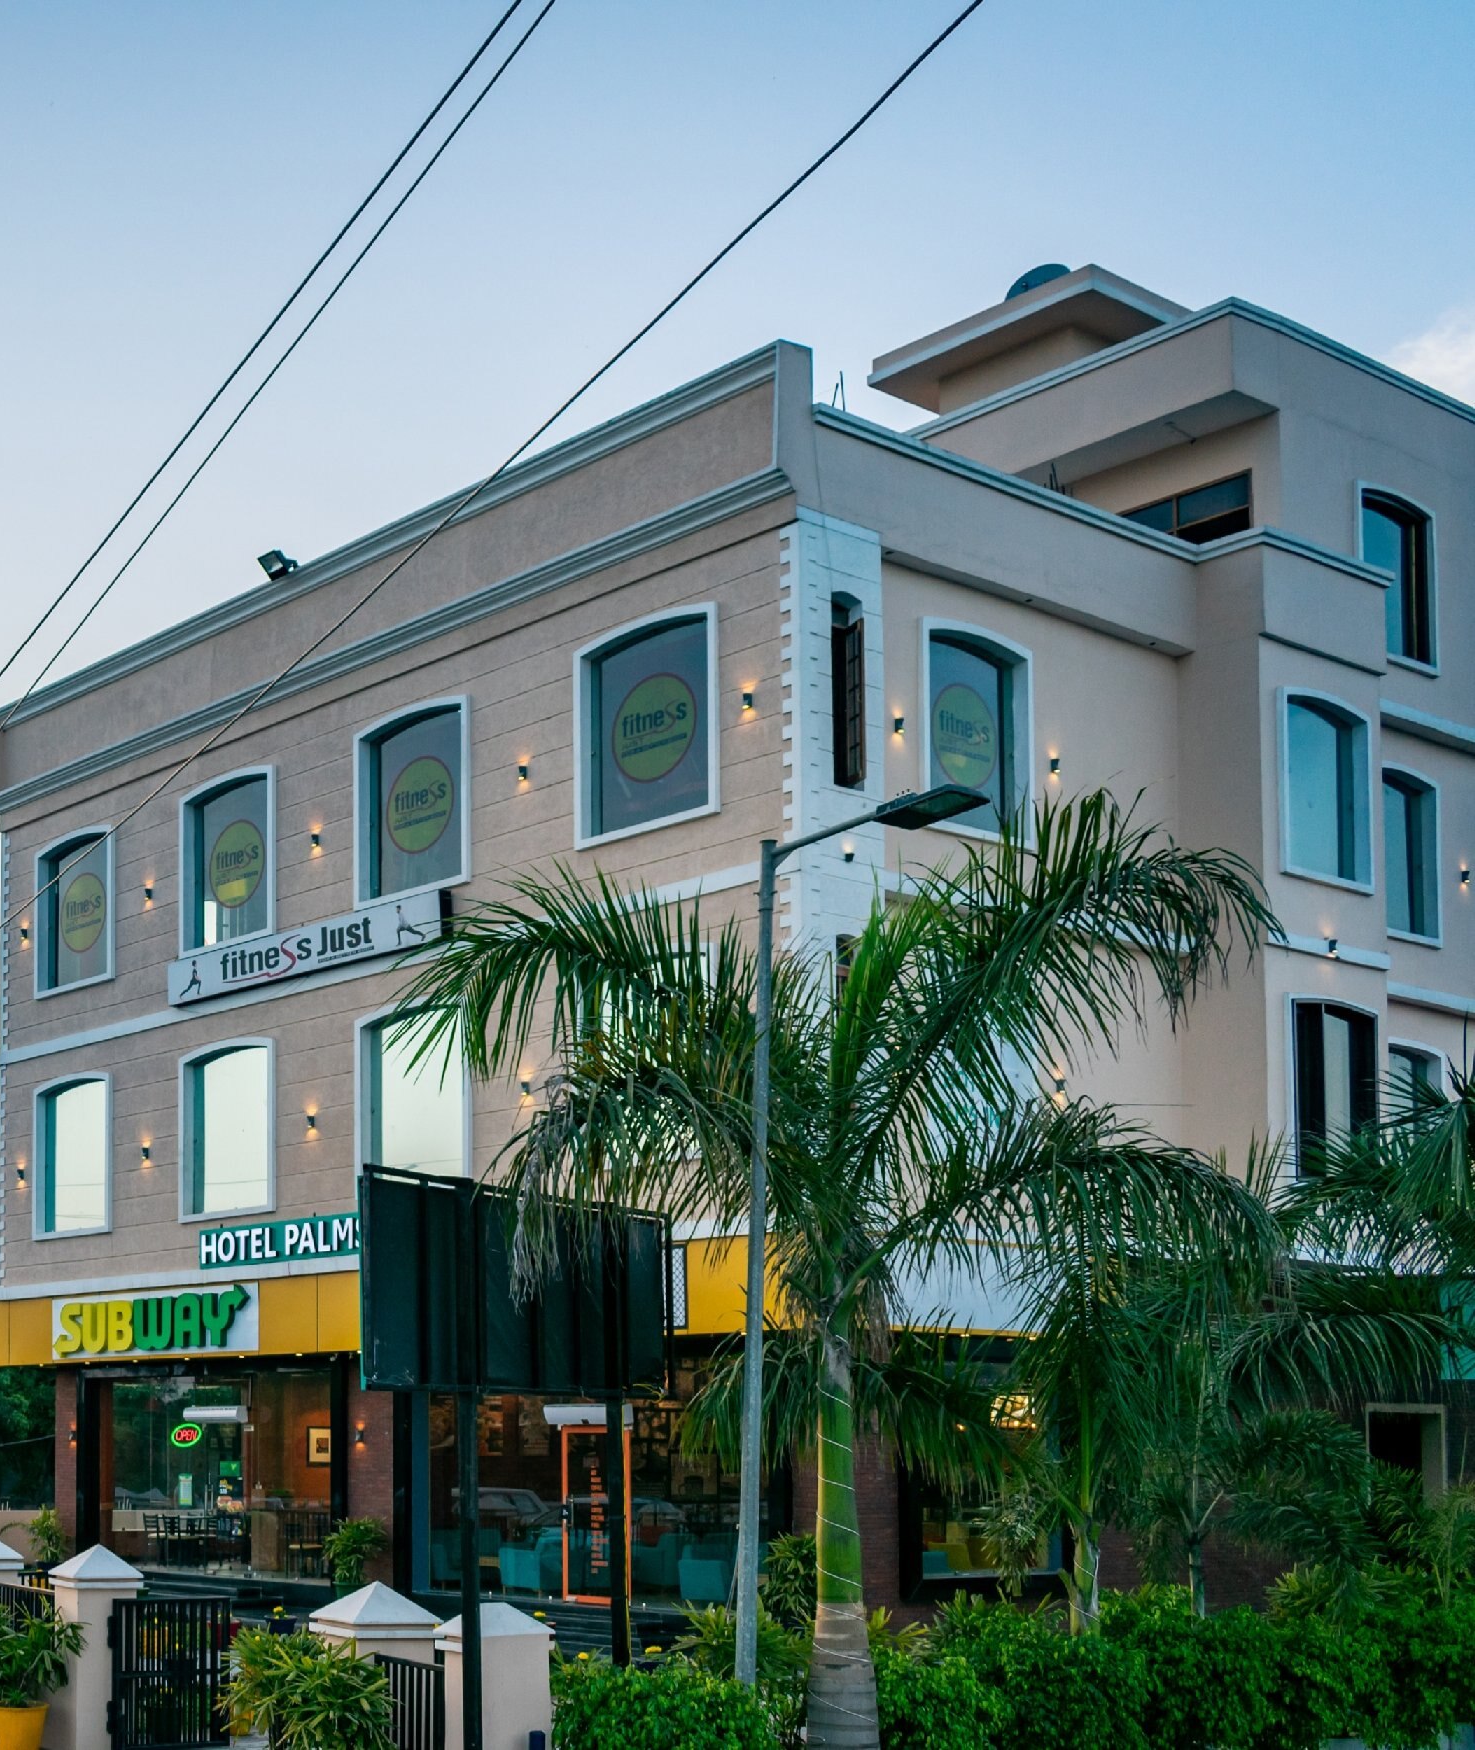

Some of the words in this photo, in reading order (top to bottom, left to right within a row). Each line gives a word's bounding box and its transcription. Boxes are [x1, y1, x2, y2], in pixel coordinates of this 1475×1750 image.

[622, 700, 687, 738] fitness
[939, 709, 990, 744] fitness
[395, 780, 447, 813] fitness
[216, 843, 259, 871] fitness
[220, 933, 311, 983] fitness
[317, 917, 372, 957] Just
[201, 1227, 277, 1265] HOTEL
[284, 1217, 360, 1256] PALM
[53, 1284, 250, 1358] SUBWAY
[176, 1429, 197, 1441] OPEN
